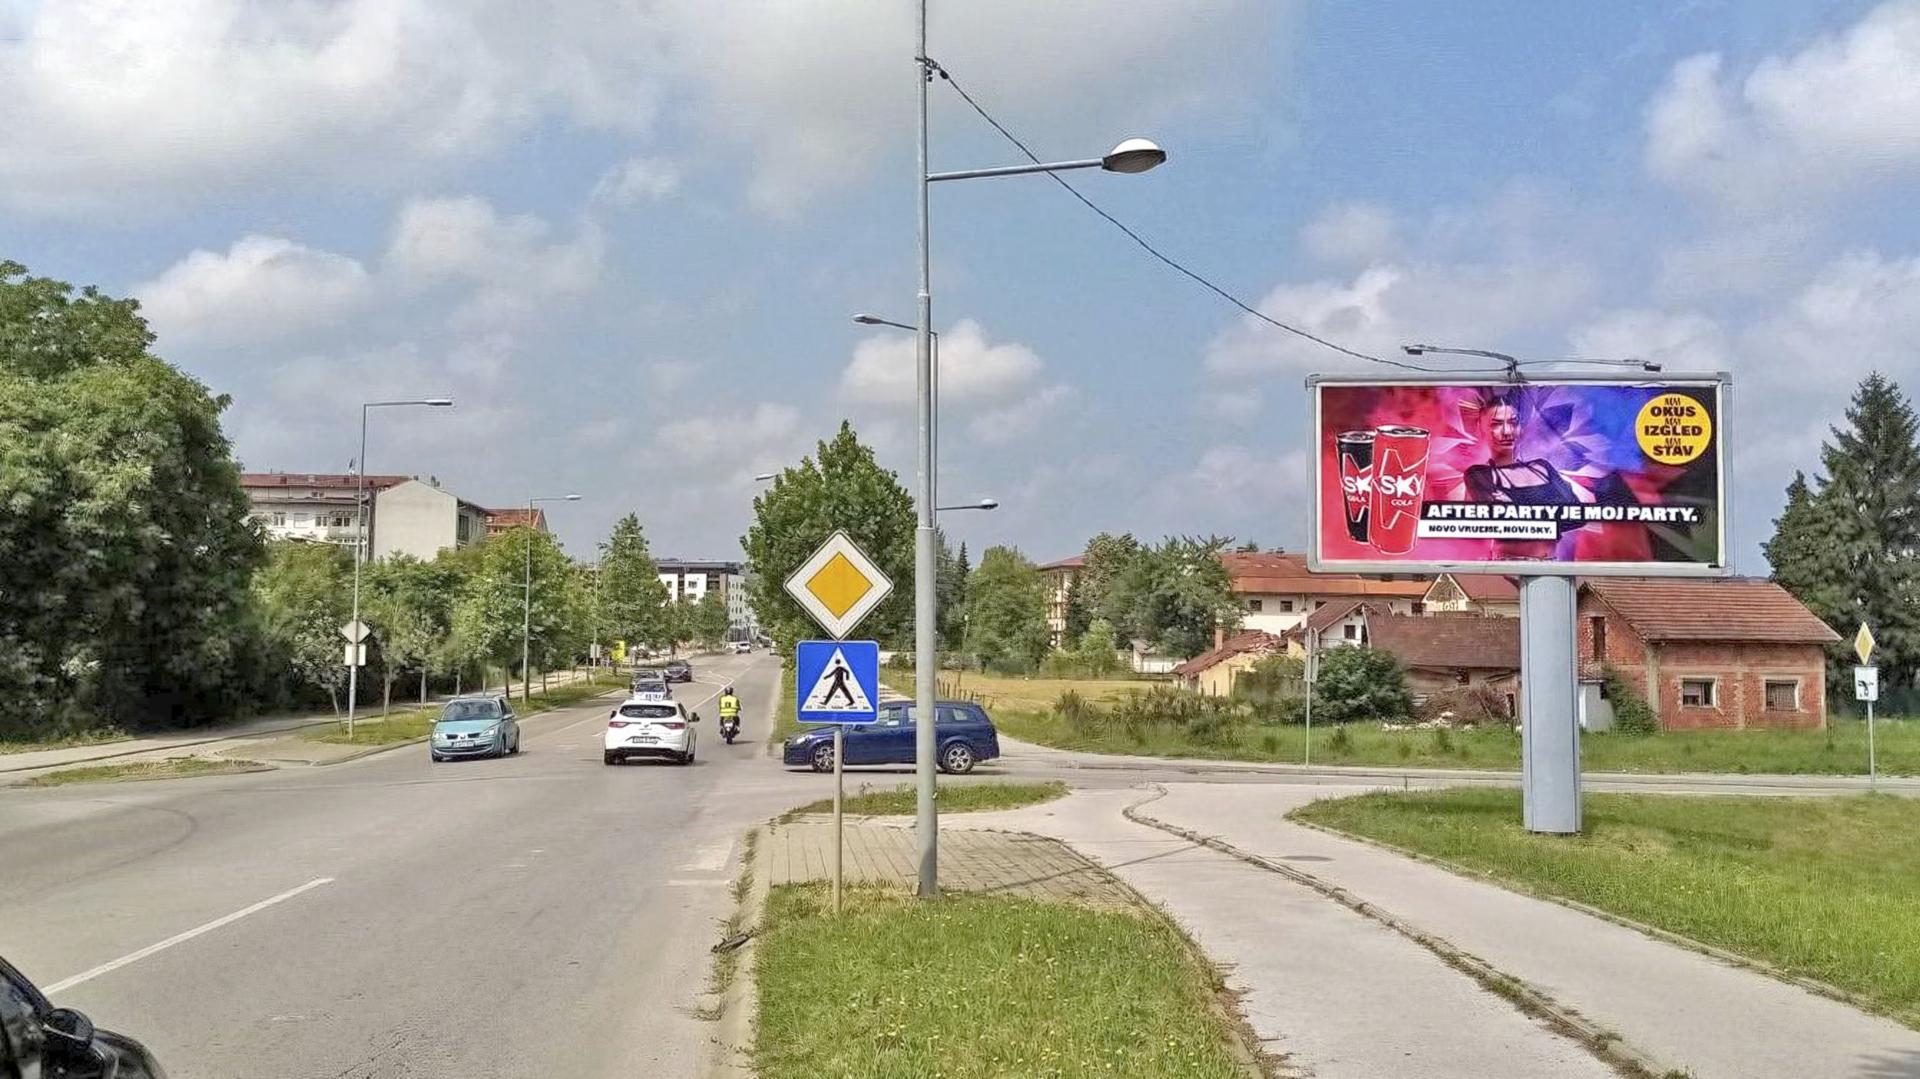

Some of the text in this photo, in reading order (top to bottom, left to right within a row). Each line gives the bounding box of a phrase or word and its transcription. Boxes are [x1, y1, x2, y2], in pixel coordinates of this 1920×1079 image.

[1650, 406, 1696, 417] OKUS
[1644, 425, 1703, 436] IZGLED
[1653, 445, 1694, 456] STAV
[1343, 475, 1373, 496] SK
[1380, 473, 1424, 498] SKY
[1427, 504, 1698, 522] AFTER PARTY JE MOJ PARTY.
[1428, 525, 1456, 533] NOVO
[1503, 525, 1529, 533] NOVI
